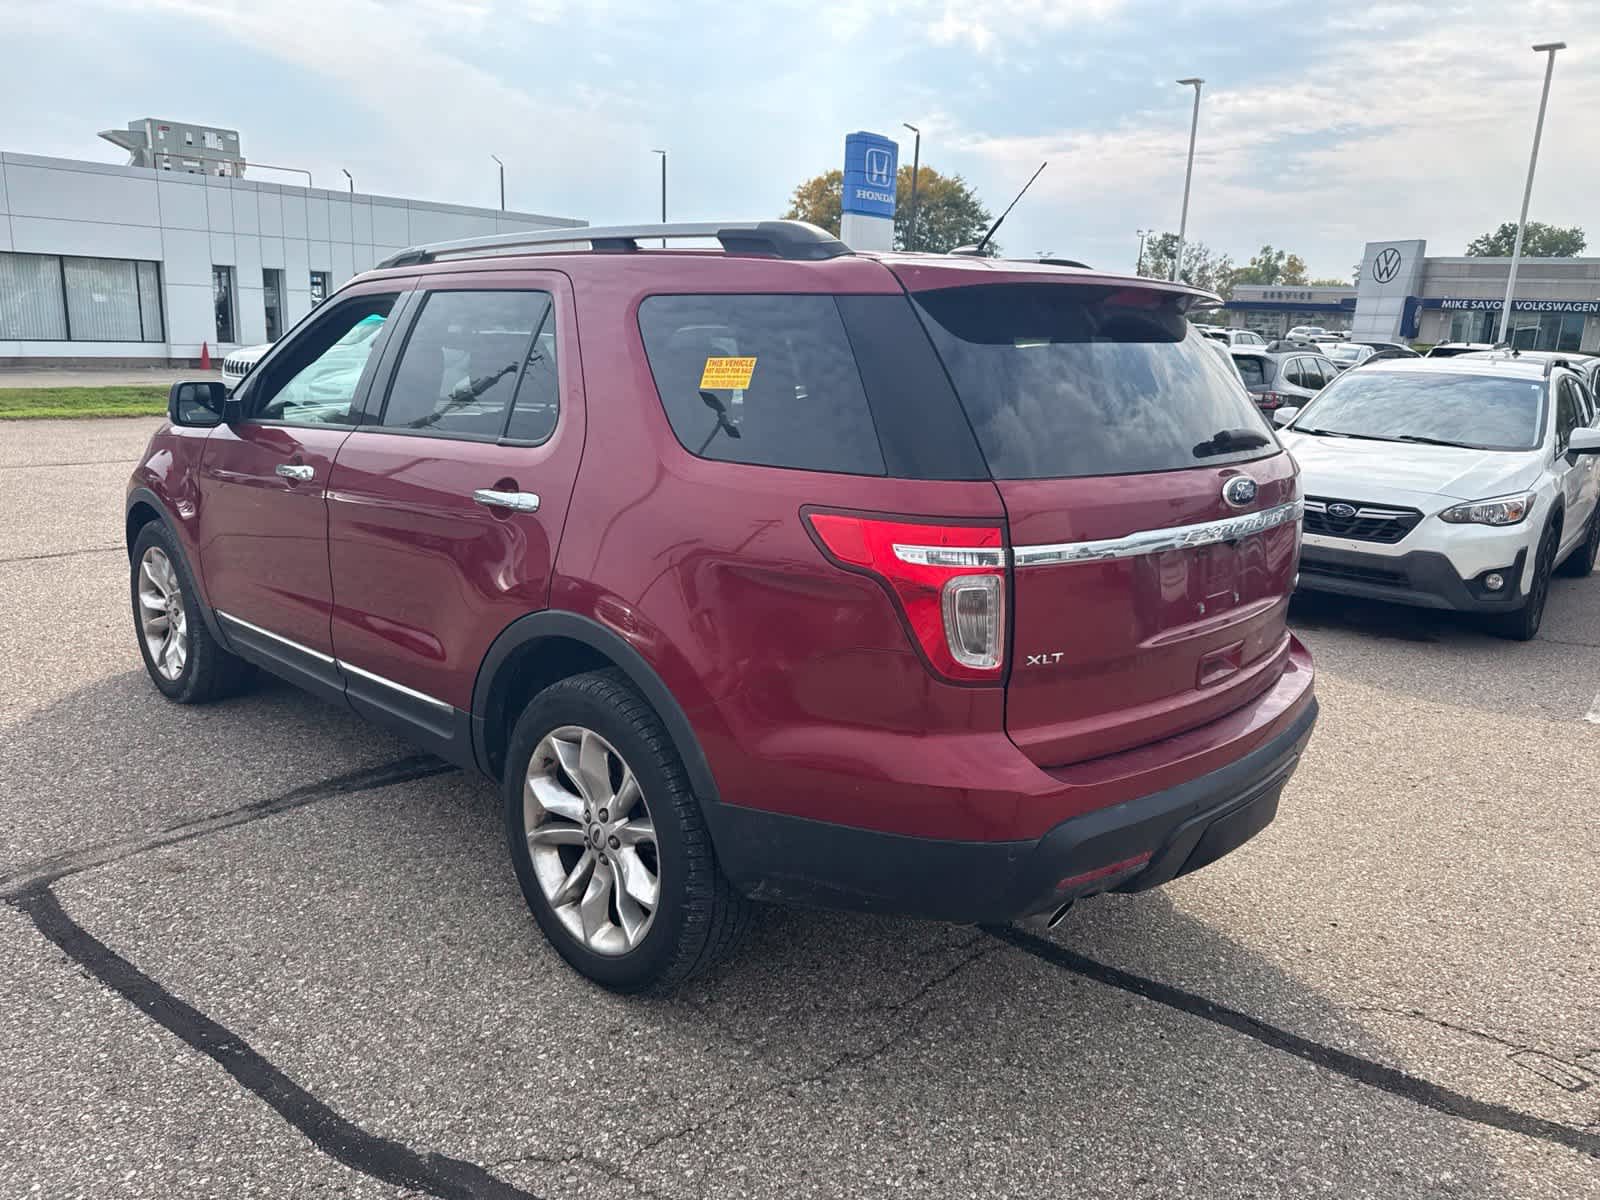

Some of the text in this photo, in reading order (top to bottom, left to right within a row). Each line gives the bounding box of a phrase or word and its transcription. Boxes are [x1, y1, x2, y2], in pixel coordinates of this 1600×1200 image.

[856, 189, 896, 204] HONDA
[1441, 300, 1469, 309] MIKE
[1515, 301, 1599, 312] VOLKSWAGEN
[708, 359, 755, 368] THIS VEHICLE
[1026, 652, 1065, 666] XLT
